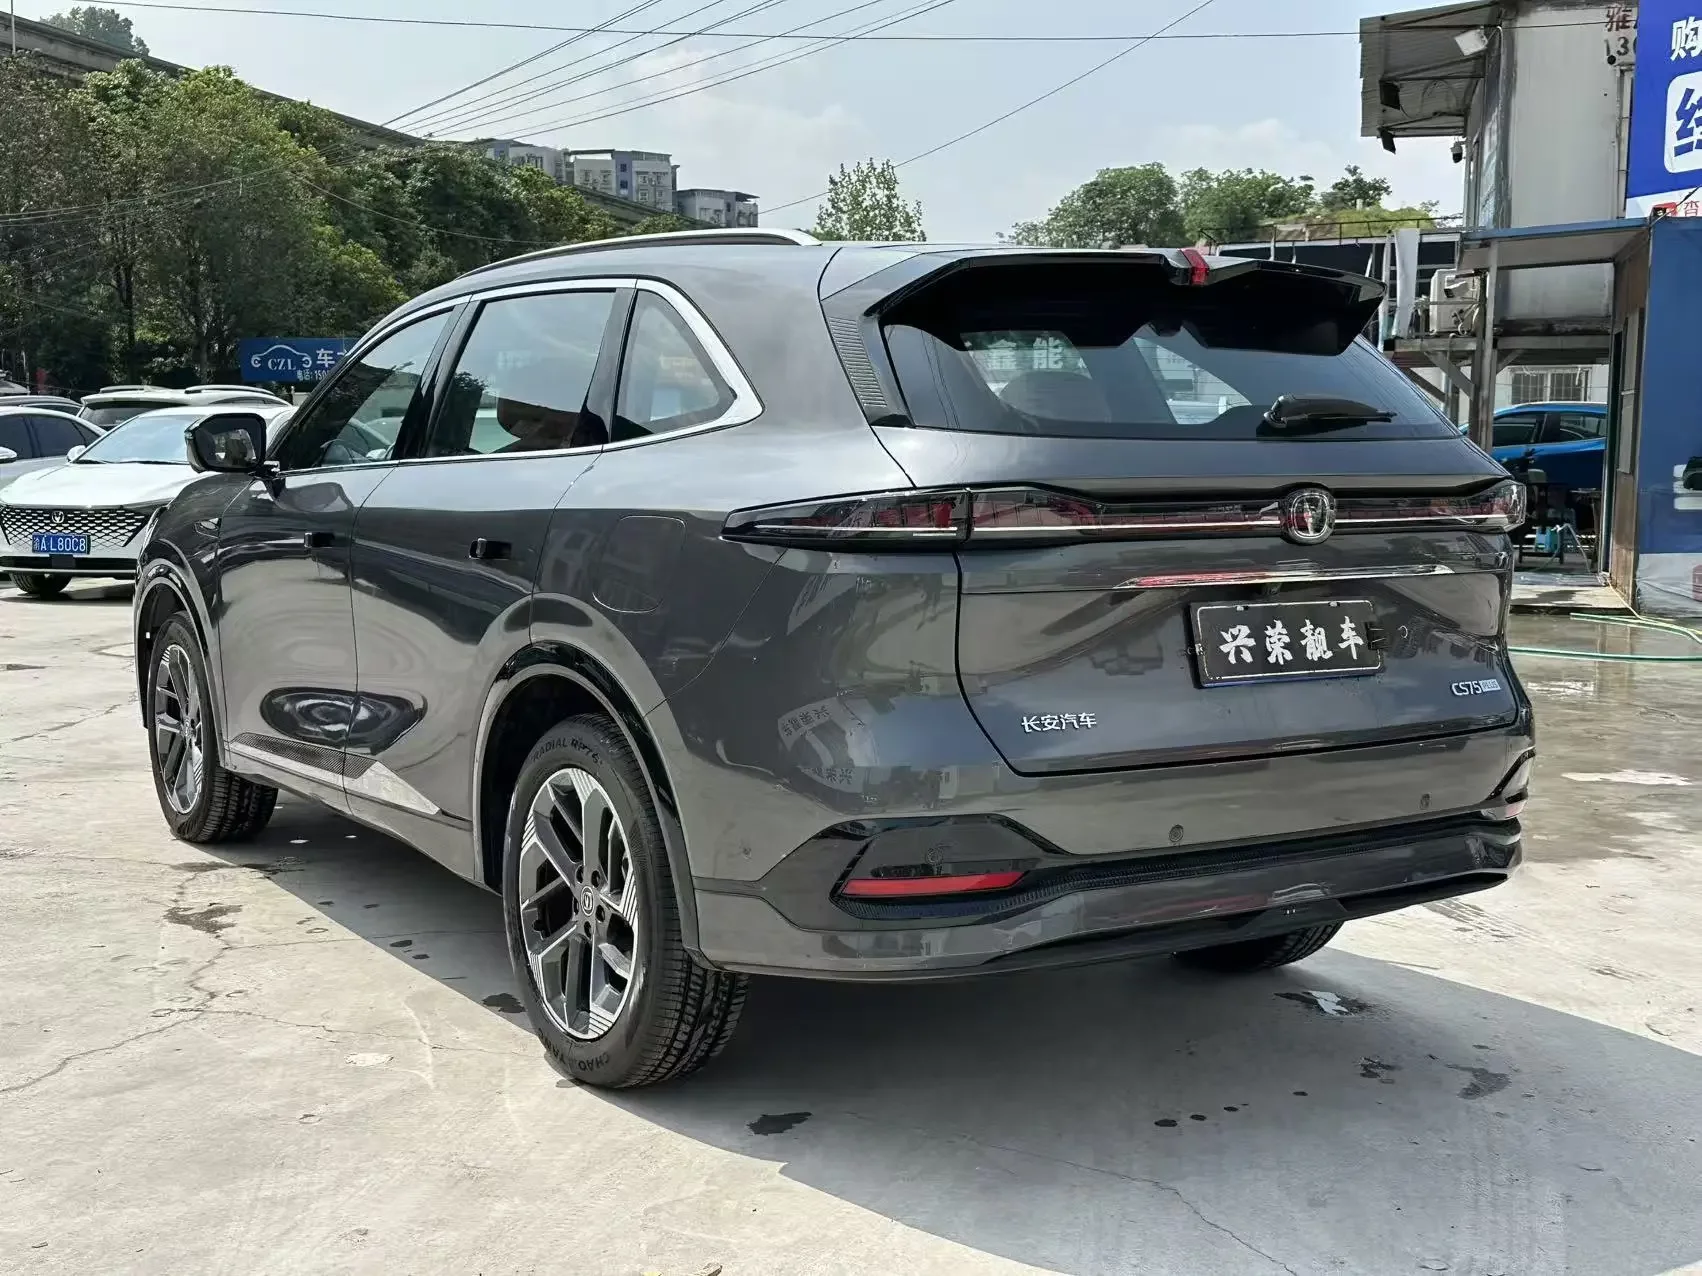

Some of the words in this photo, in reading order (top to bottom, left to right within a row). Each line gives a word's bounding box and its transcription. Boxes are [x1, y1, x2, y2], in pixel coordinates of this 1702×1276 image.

[1605, 5, 1638, 32] 雅
[1604, 36, 1638, 57] 13
[267, 358, 297, 371] CZL
[316, 348, 346, 368] 车
[1219, 615, 1365, 665] 兴荣靓车
[1451, 680, 1482, 696] CS75
[1021, 712, 1097, 733] 长安汽车
